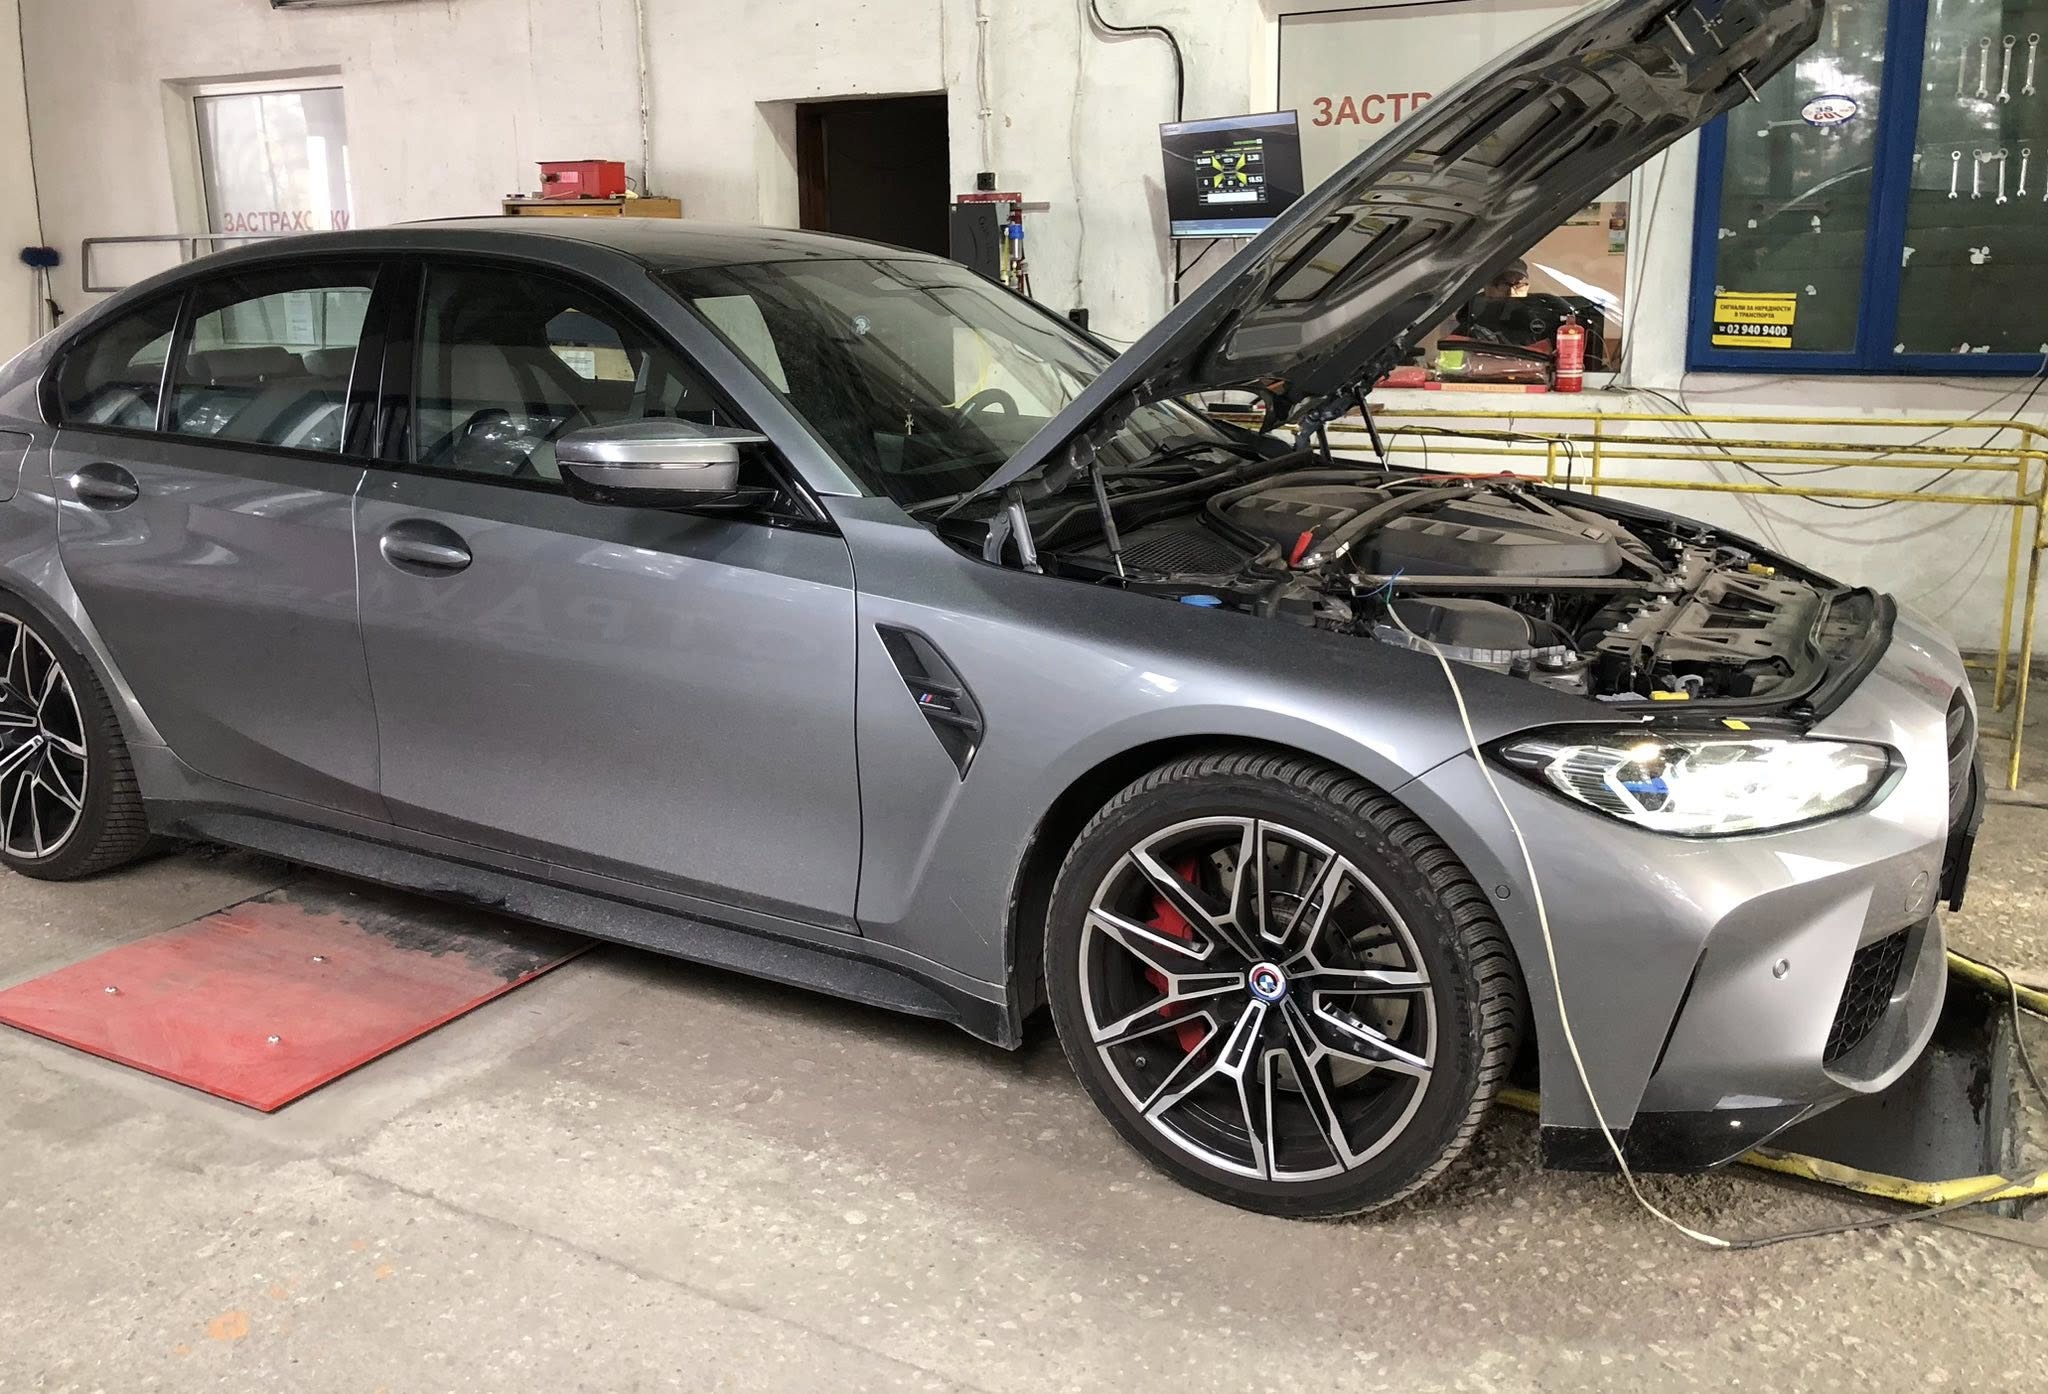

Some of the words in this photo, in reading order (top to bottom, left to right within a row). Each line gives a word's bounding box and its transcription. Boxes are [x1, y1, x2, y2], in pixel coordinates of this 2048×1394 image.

[1727, 324, 1740, 334] 02
[1741, 325, 1760, 335] 940
[1762, 325, 1788, 336] 9400
